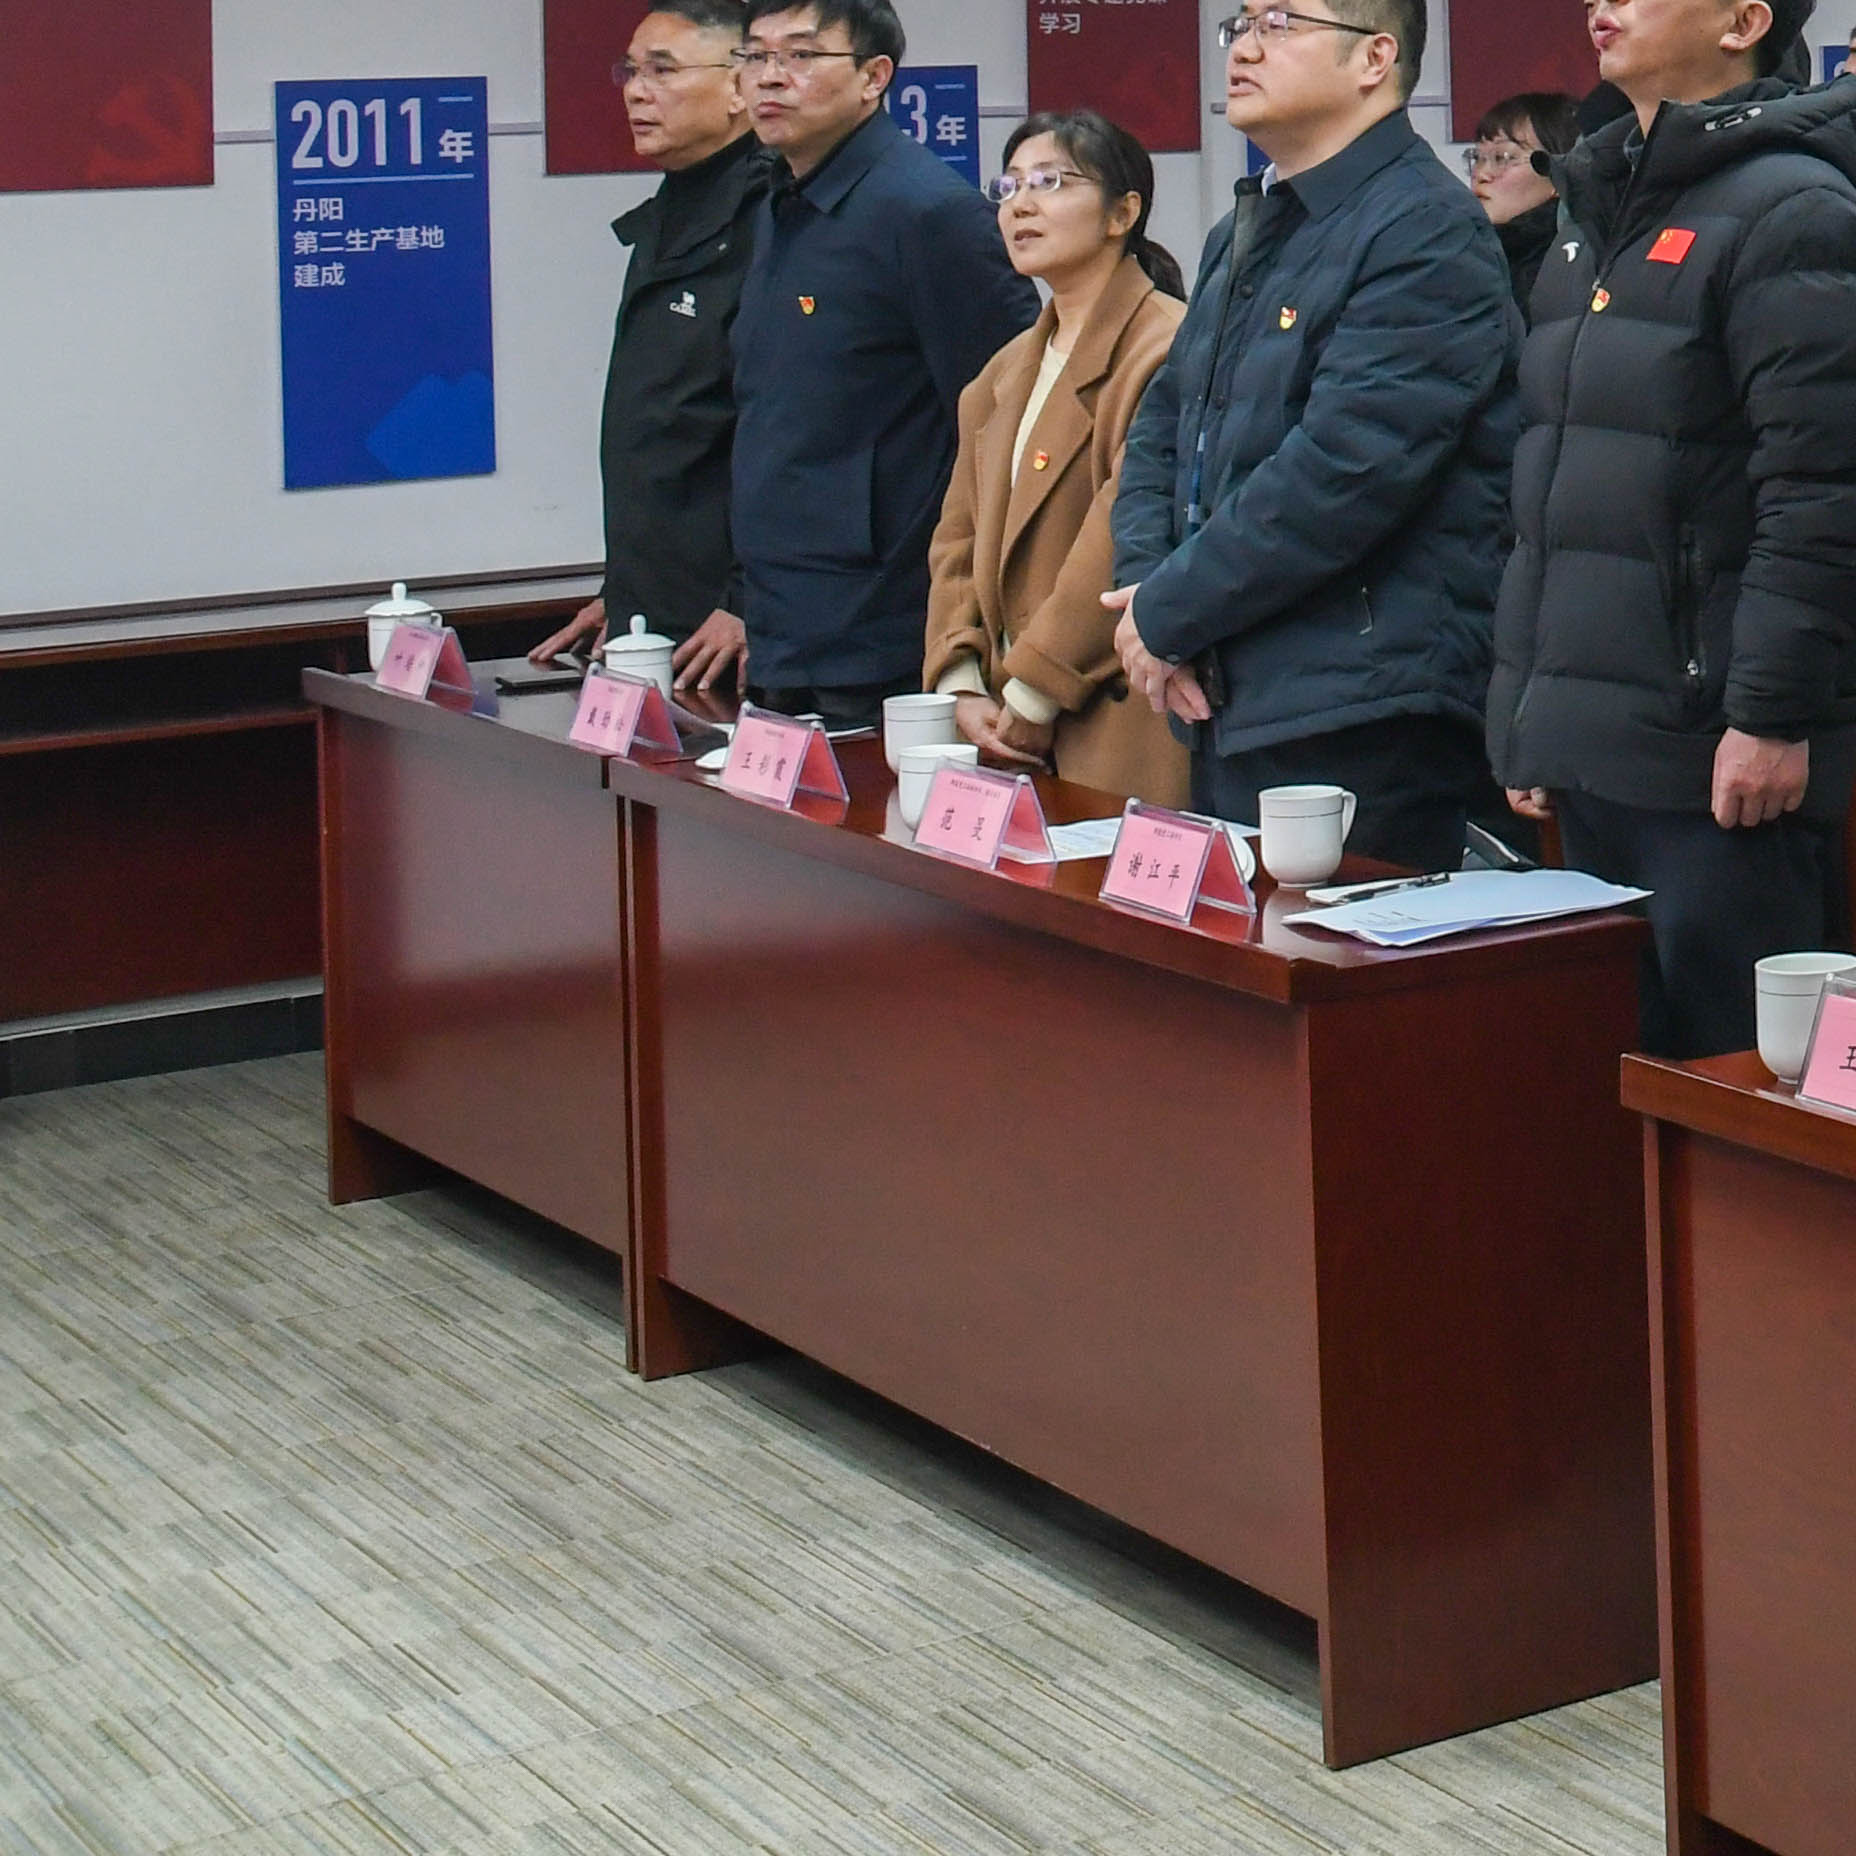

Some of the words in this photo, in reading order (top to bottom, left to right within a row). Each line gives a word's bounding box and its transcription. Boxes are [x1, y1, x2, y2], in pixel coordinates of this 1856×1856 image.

[1039, 12, 1081, 34] 学习
[291, 97, 475, 169] 2011年
[293, 197, 344, 222] 丹阳
[293, 225, 445, 255] 第二生产基地
[294, 261, 346, 288] 建成
